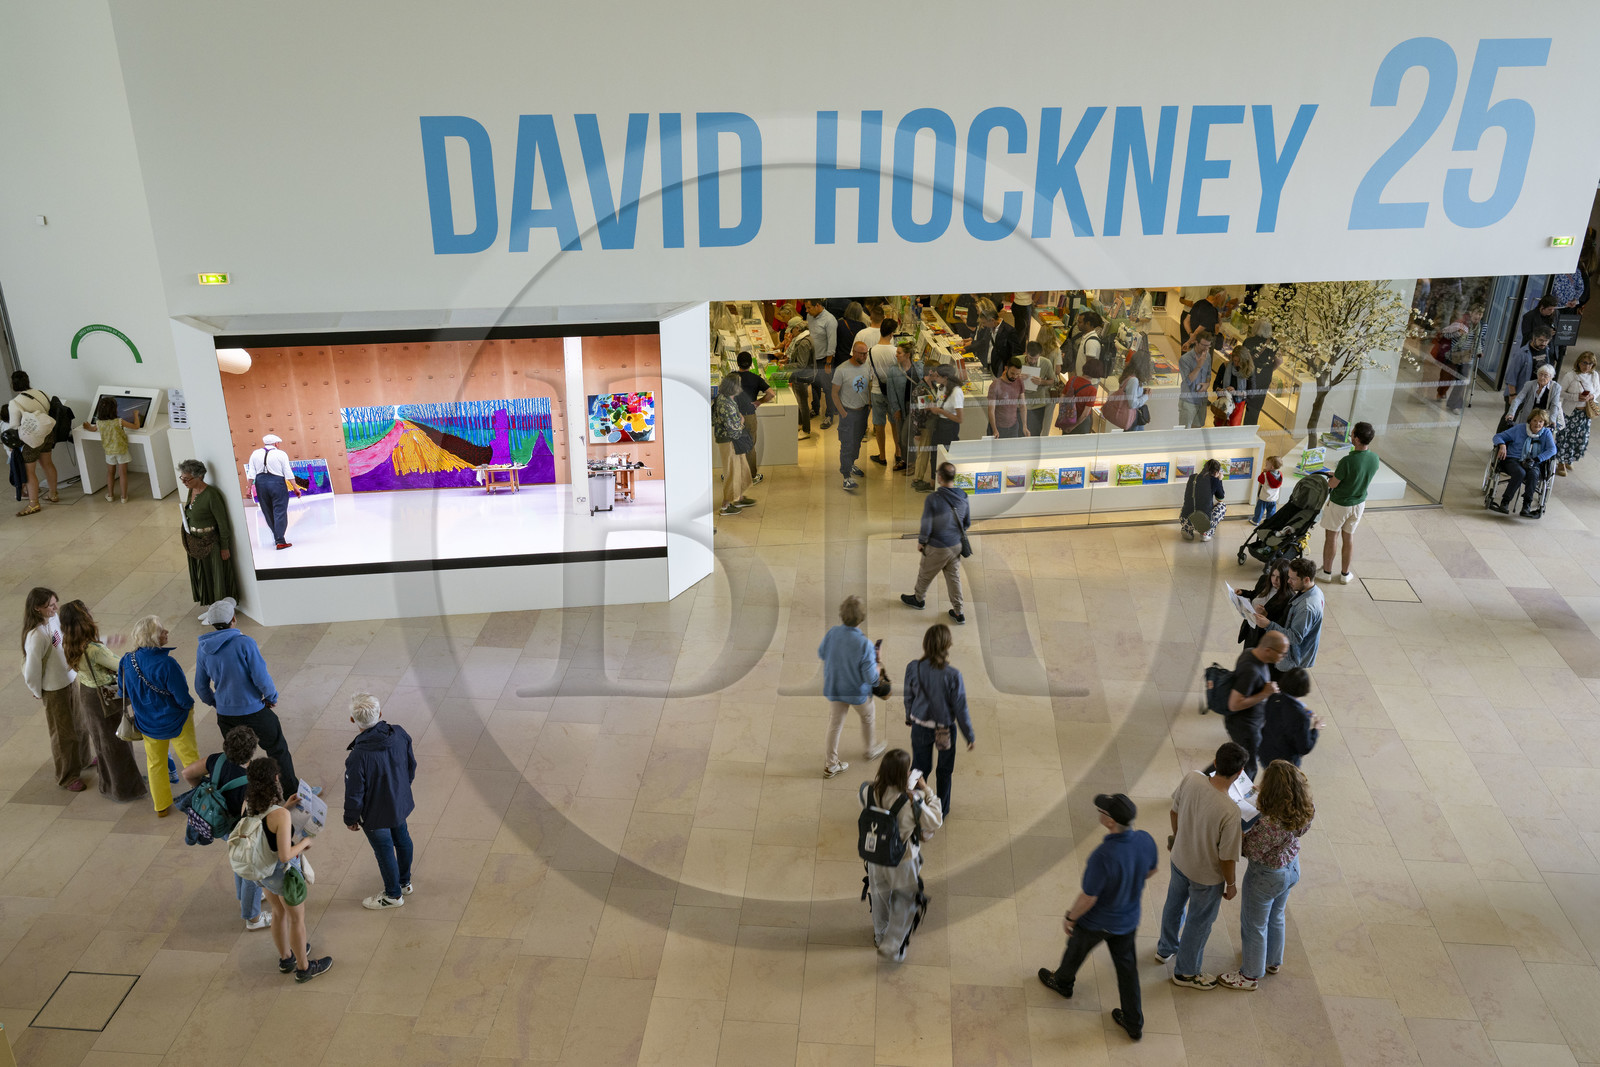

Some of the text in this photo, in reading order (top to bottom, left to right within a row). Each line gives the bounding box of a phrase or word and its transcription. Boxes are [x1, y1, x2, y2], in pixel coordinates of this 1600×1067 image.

[419, 36, 1553, 255] DAVID HOCKNEY 25
